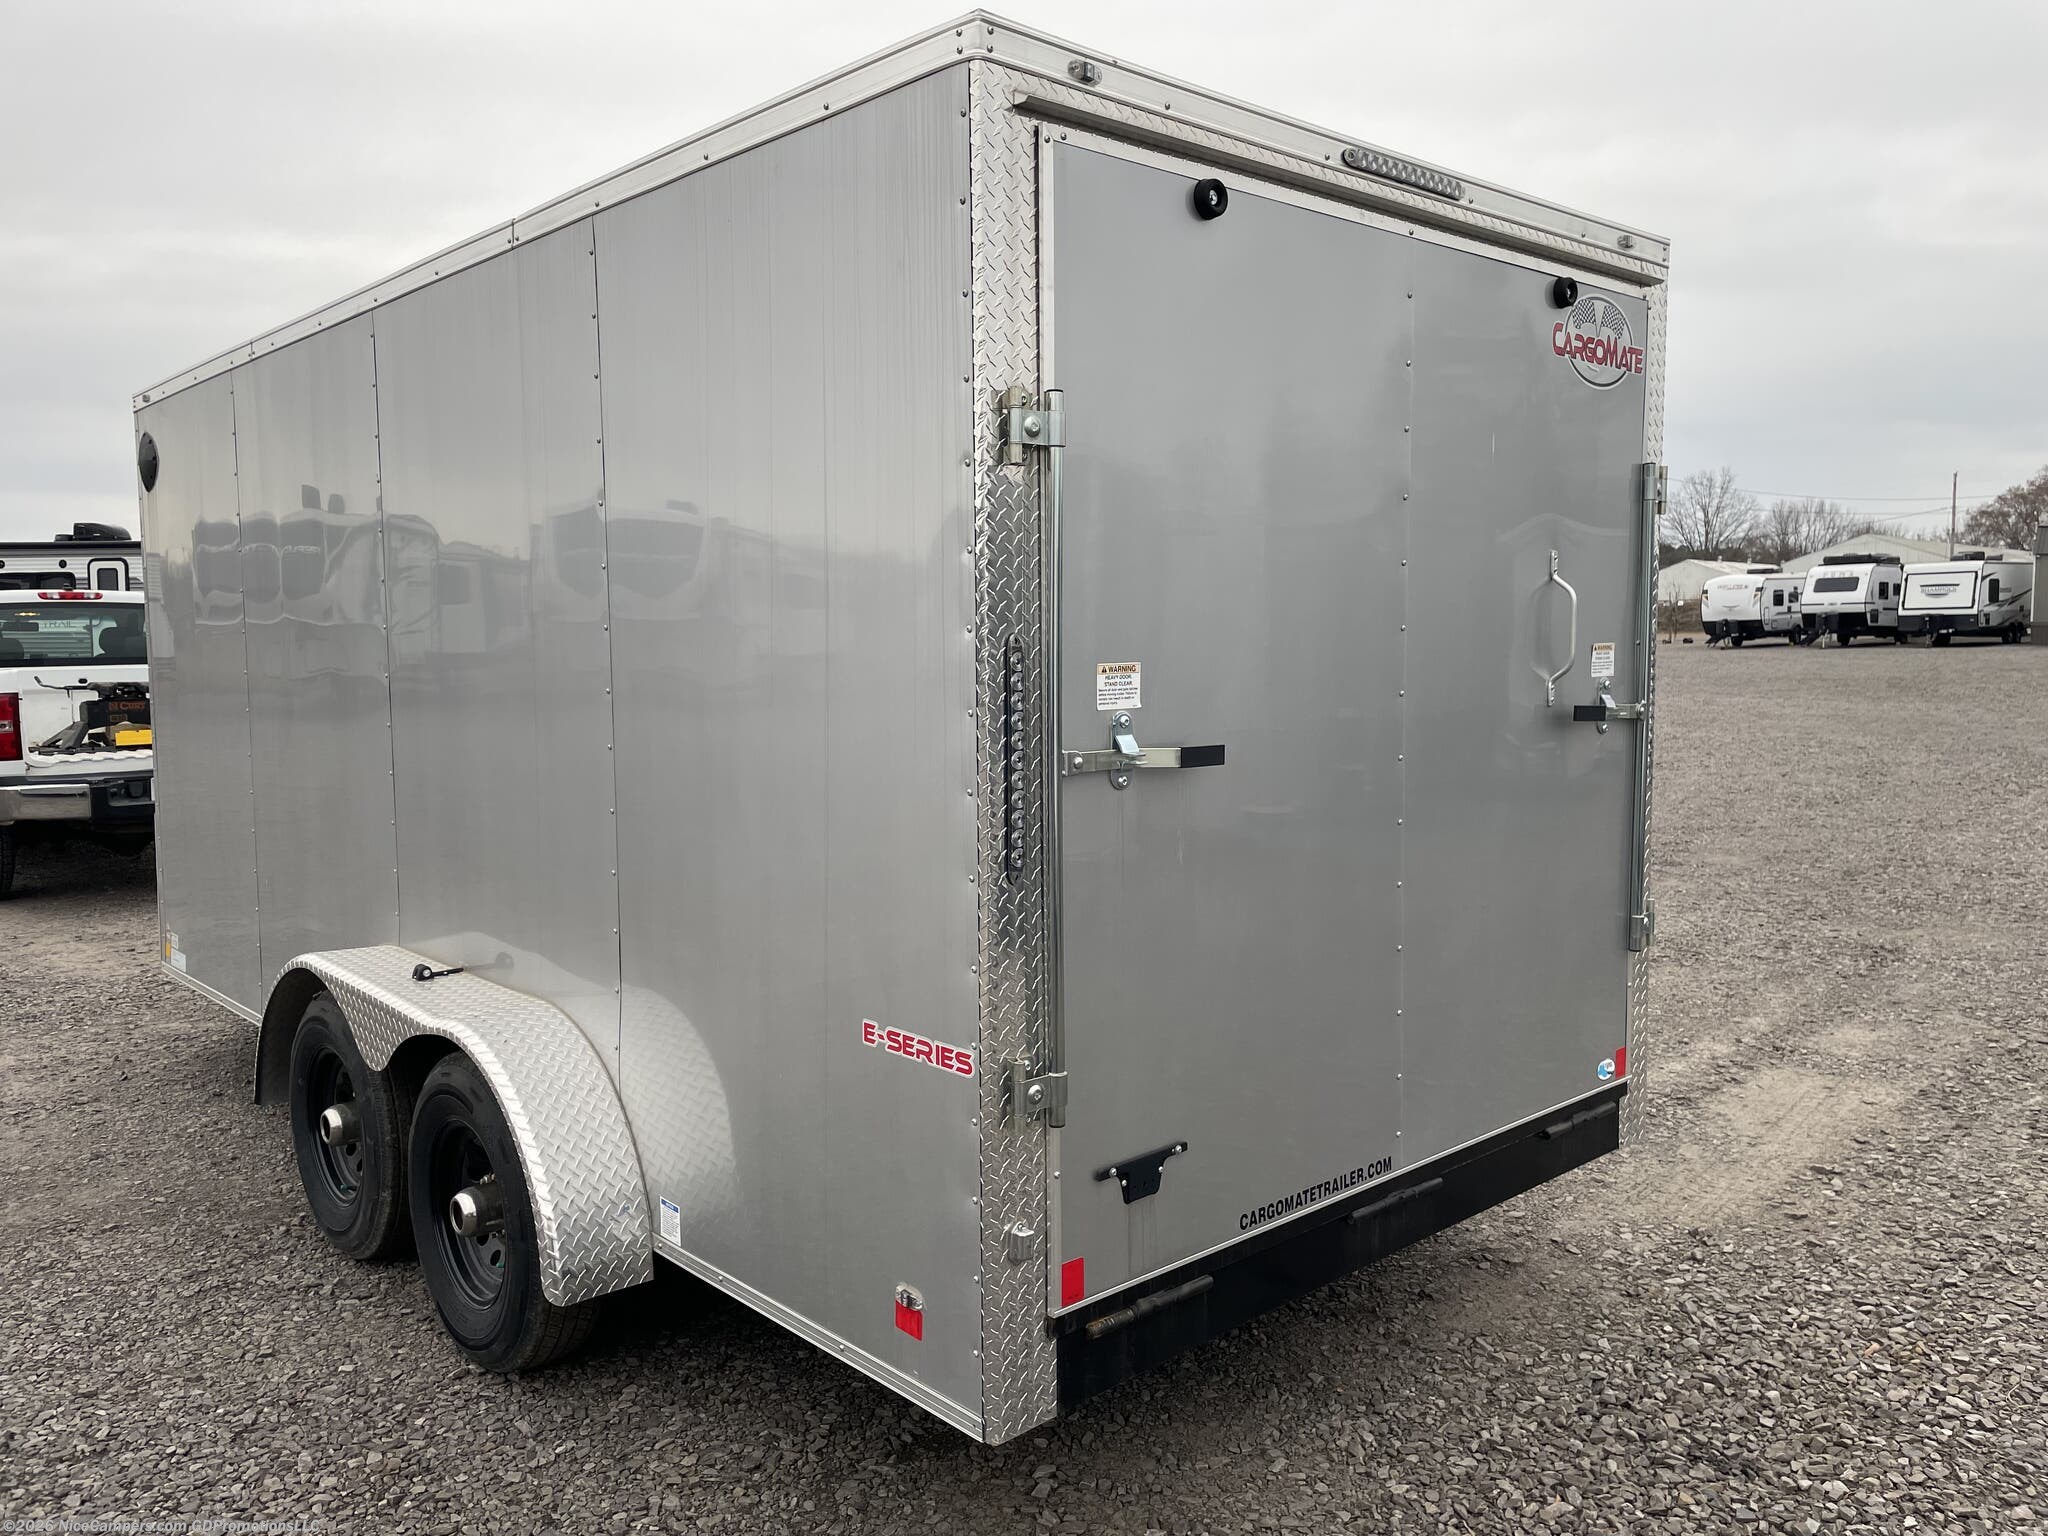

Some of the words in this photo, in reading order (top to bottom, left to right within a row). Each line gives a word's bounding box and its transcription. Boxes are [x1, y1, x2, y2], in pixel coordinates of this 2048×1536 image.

[1552, 321, 1644, 375] CARGOMATE
[1108, 664, 1136, 673] WARNING
[863, 1021, 974, 1076] E-SERIES
[1239, 1156, 1393, 1231] CARGOMATETRAILER.COM
